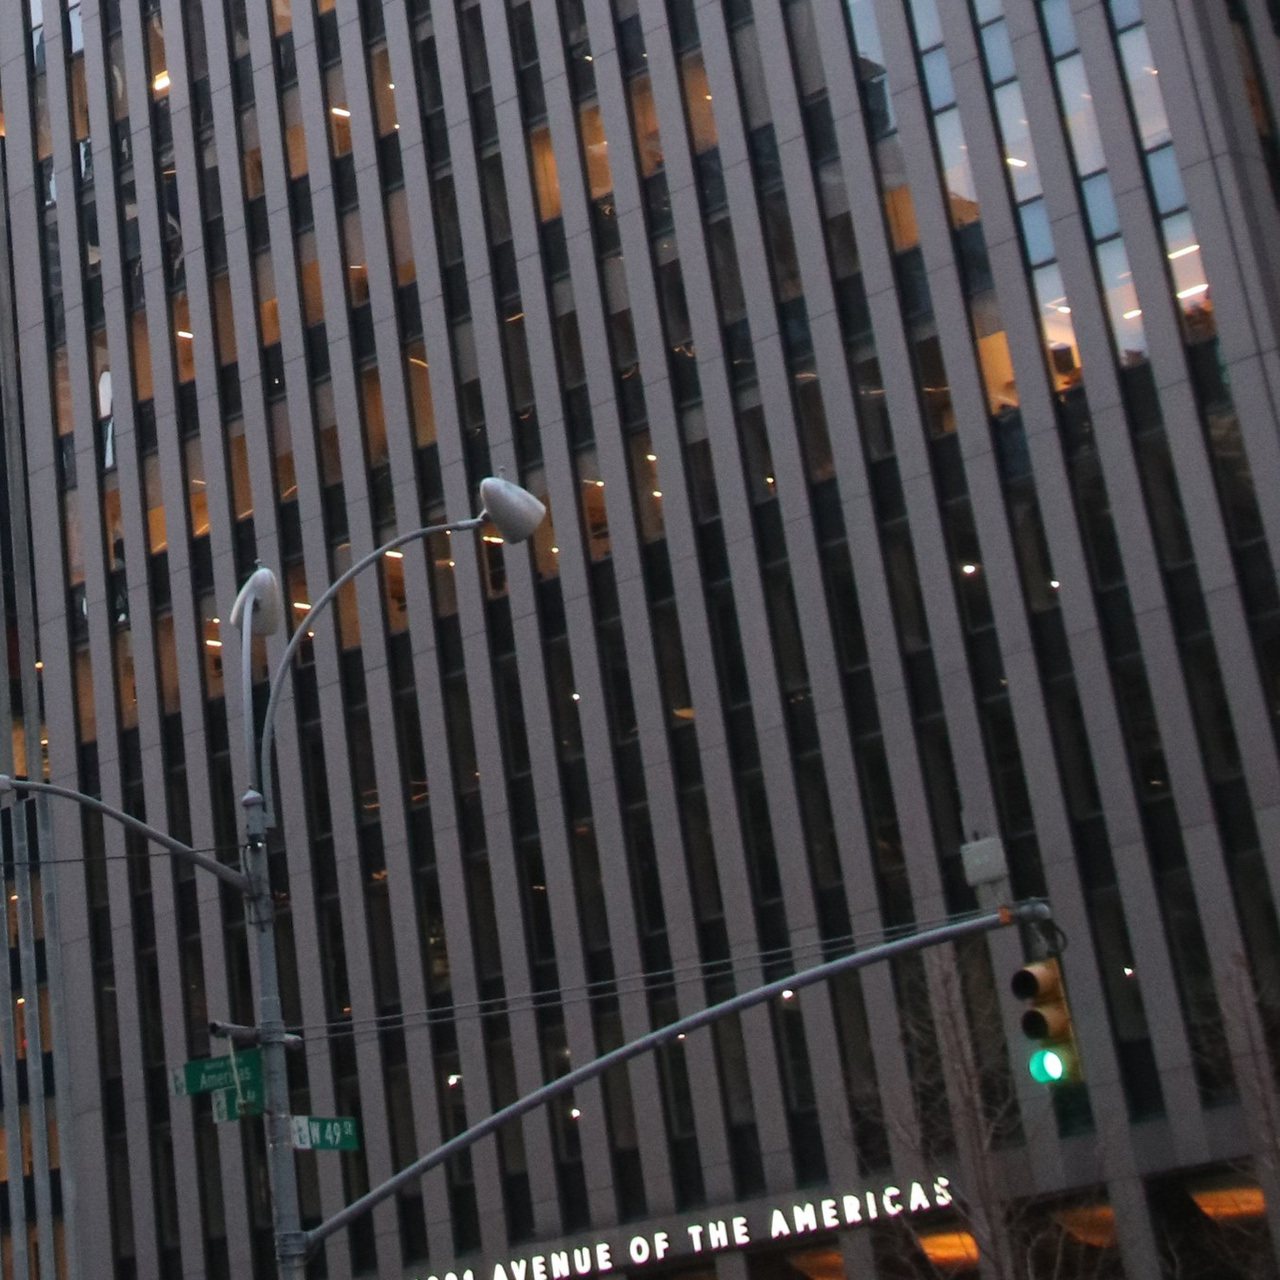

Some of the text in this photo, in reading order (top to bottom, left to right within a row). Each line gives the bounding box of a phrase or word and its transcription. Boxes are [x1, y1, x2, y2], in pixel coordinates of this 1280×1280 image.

[200, 1067, 251, 1090] Amerias
[309, 1121, 320, 1144] W
[325, 1122, 341, 1145] 49
[493, 1176, 953, 1280] AVENUE OF THE AMERICAS
